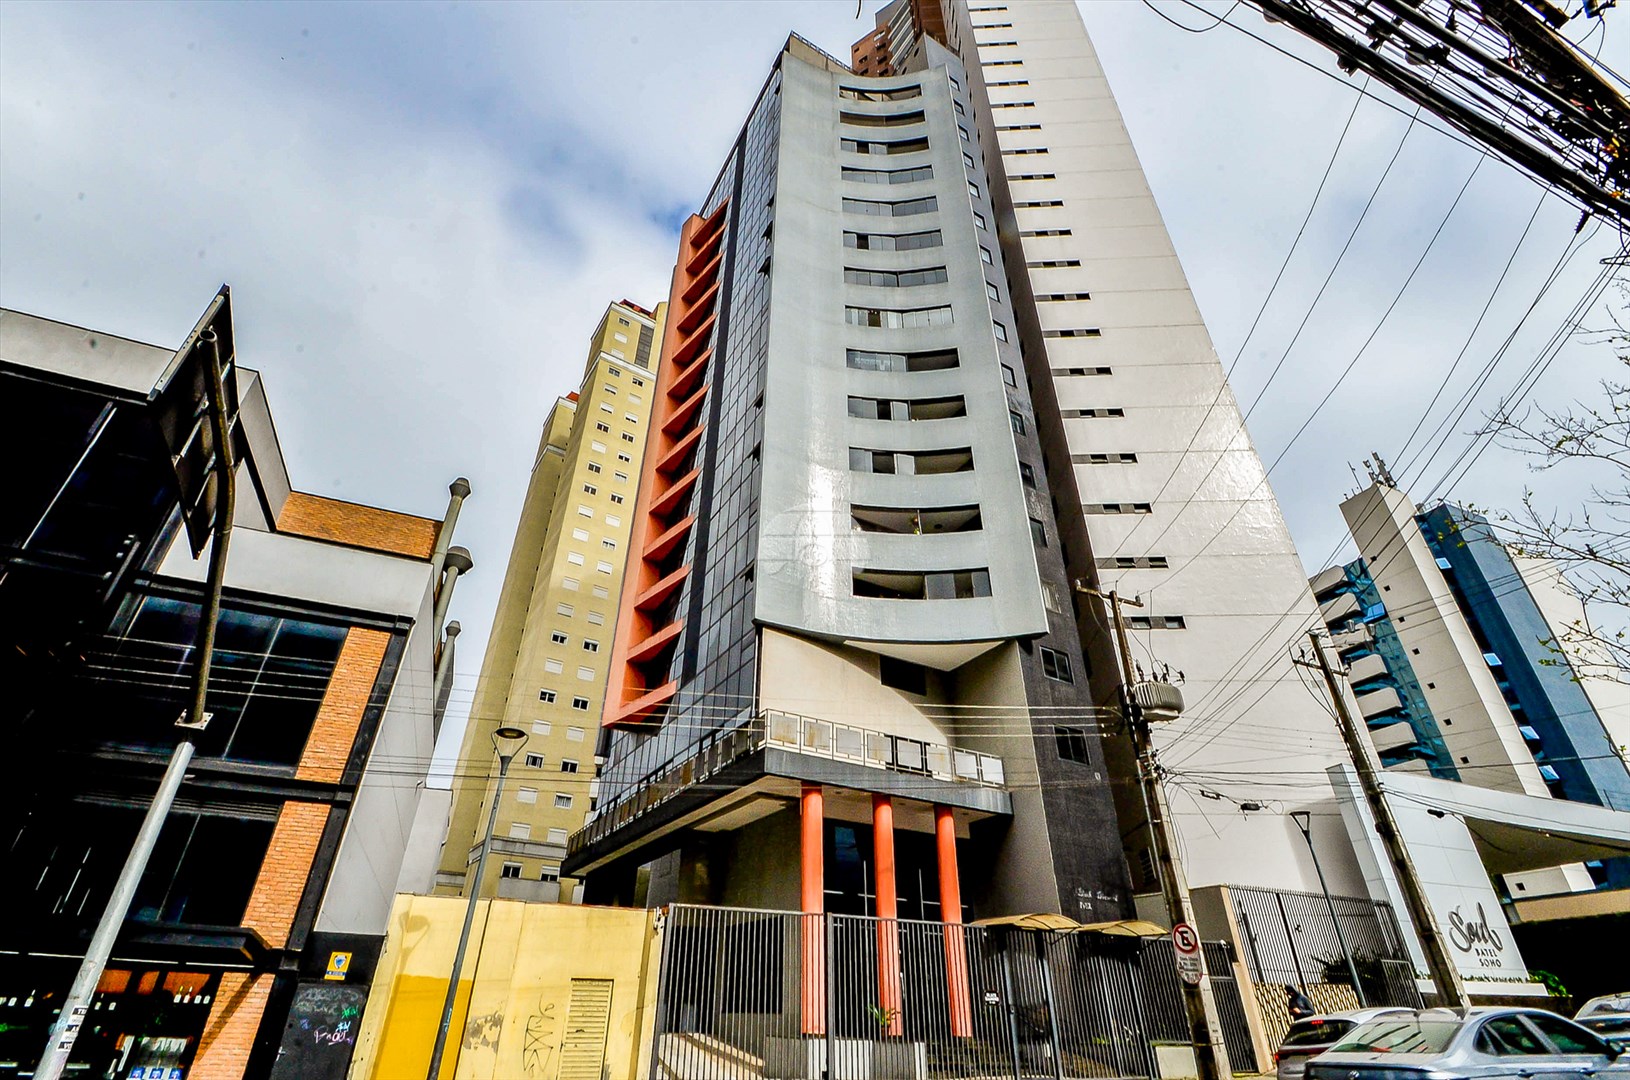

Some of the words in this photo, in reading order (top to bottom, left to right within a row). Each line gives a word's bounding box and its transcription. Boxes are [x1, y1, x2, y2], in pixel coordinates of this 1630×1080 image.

[1448, 902, 1503, 952] Soul
[1474, 948, 1498, 958] BATEL
[1479, 958, 1502, 968] SOHO
